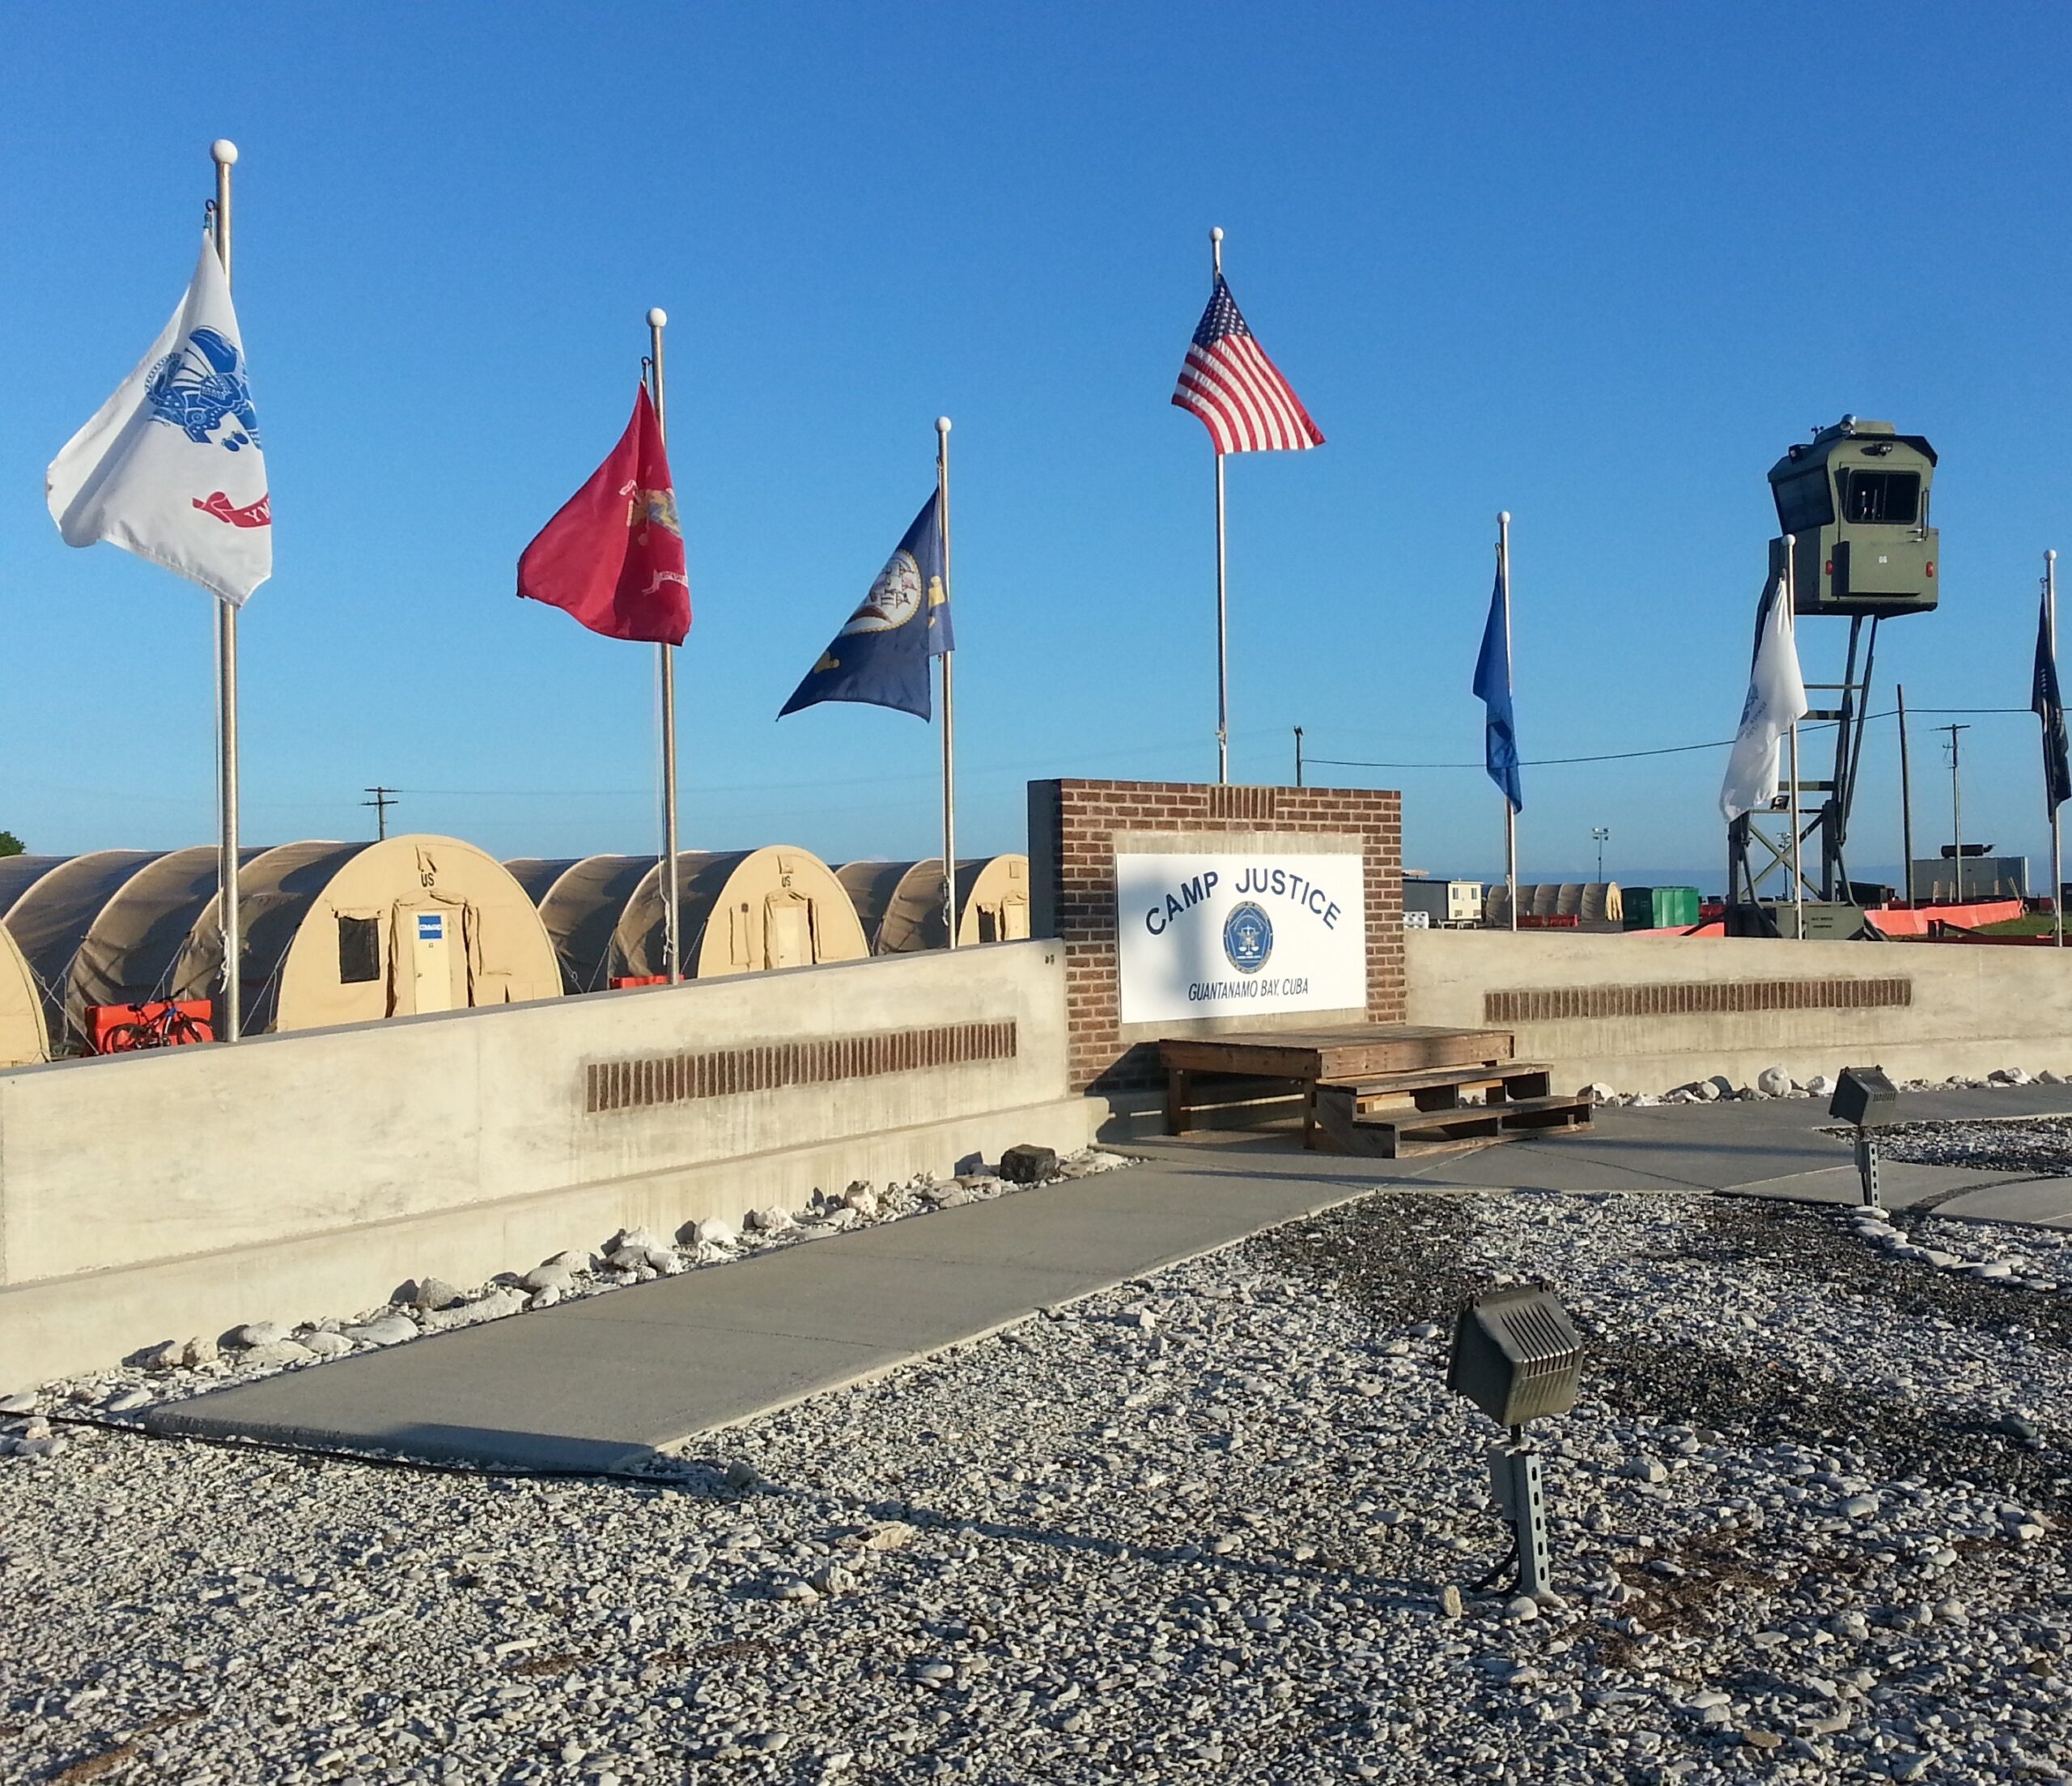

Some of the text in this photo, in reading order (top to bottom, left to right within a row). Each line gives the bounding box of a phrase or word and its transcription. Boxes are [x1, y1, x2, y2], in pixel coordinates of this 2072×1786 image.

[420, 872, 435, 887] US
[1146, 868, 1341, 935] CAMP JUSTICE
[1188, 980, 1259, 1001] GUANTANAMO
[1282, 978, 1309, 995] CUBA
